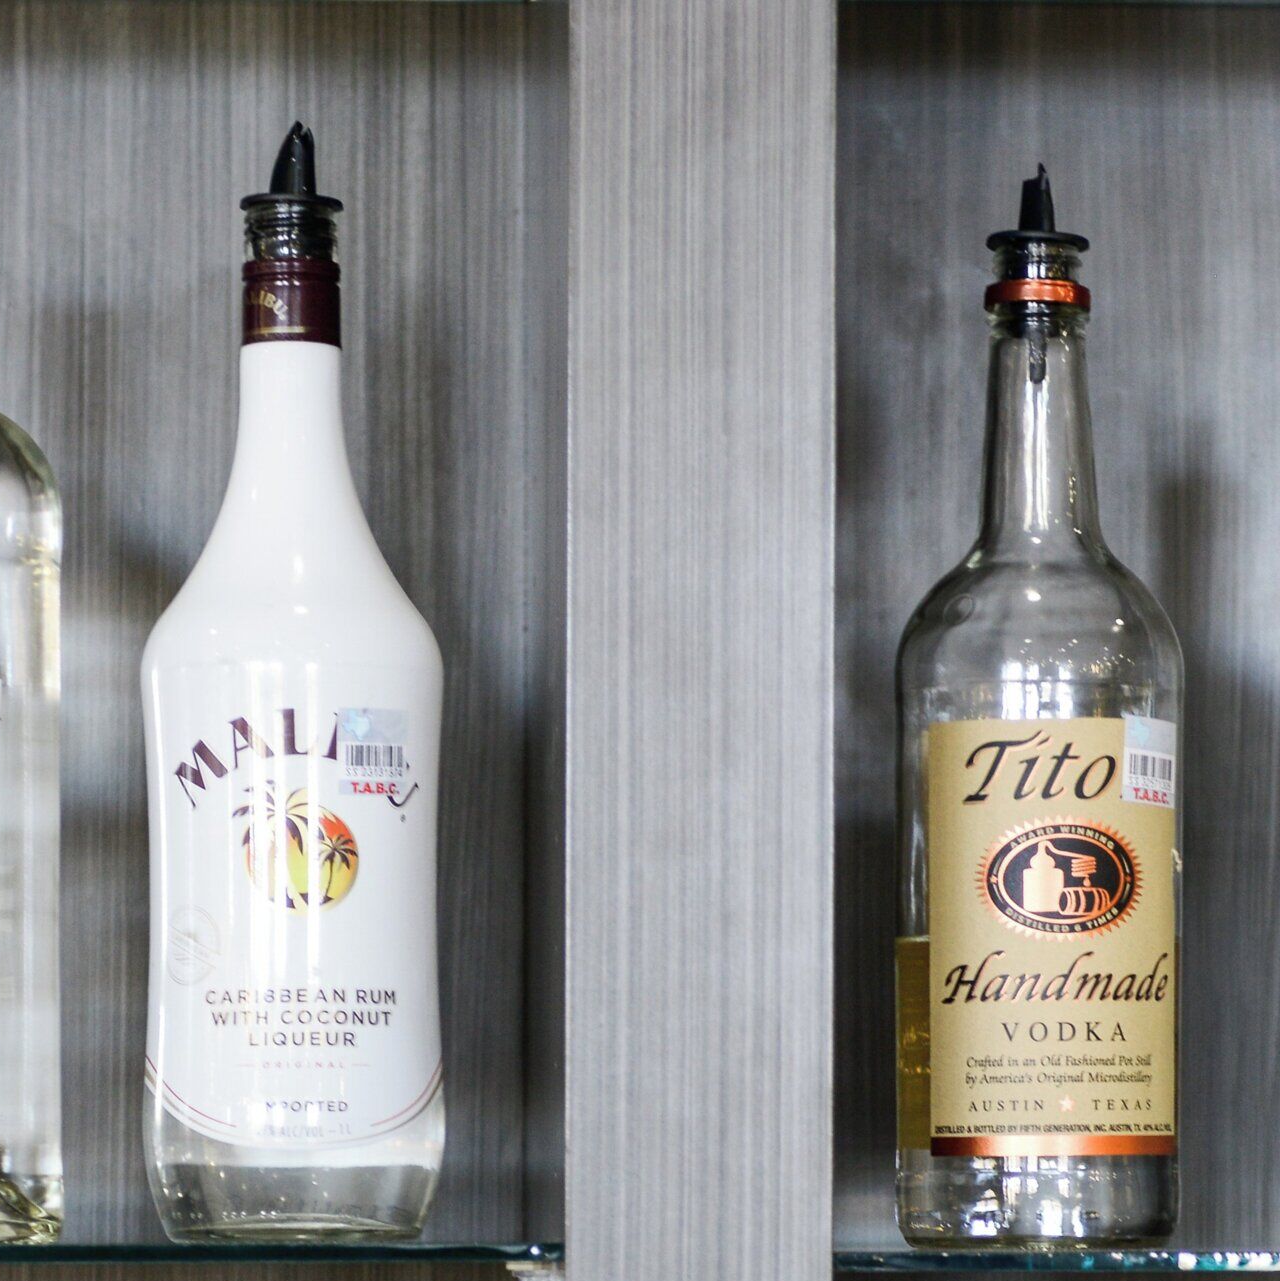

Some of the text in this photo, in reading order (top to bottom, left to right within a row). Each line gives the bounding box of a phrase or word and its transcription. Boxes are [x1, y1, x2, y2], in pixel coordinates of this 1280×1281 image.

[351, 781, 400, 795] T.A.B.C.
[1010, 825, 1115, 850] AWARD WINNING
[1004, 907, 1119, 933] DISTILLED 6 TIMES
[941, 949, 1169, 1005] Handmade
[205, 989, 397, 1005] CARIBBEAN RUM
[211, 1010, 393, 1027] WITH COCONUT
[248, 1031, 357, 1047] LIQUEUR
[1001, 1021, 1128, 1043] VODKA
[261, 1060, 346, 1069] ORIGINAL
[966, 1055, 1003, 1072] Crafted
[1008, 1056, 1019, 1067] in
[1023, 1058, 1036, 1067] an
[1040, 1055, 1061, 1067] Old
[1066, 1055, 1116, 1067] Fashioned
[1119, 1055, 1133, 1067] Pot
[966, 1072, 978, 1088] by
[980, 1072, 1033, 1085] America's
[1037, 1072, 1084, 1087] Original
[968, 1099, 1152, 1113] AUSTIN TEXAS
